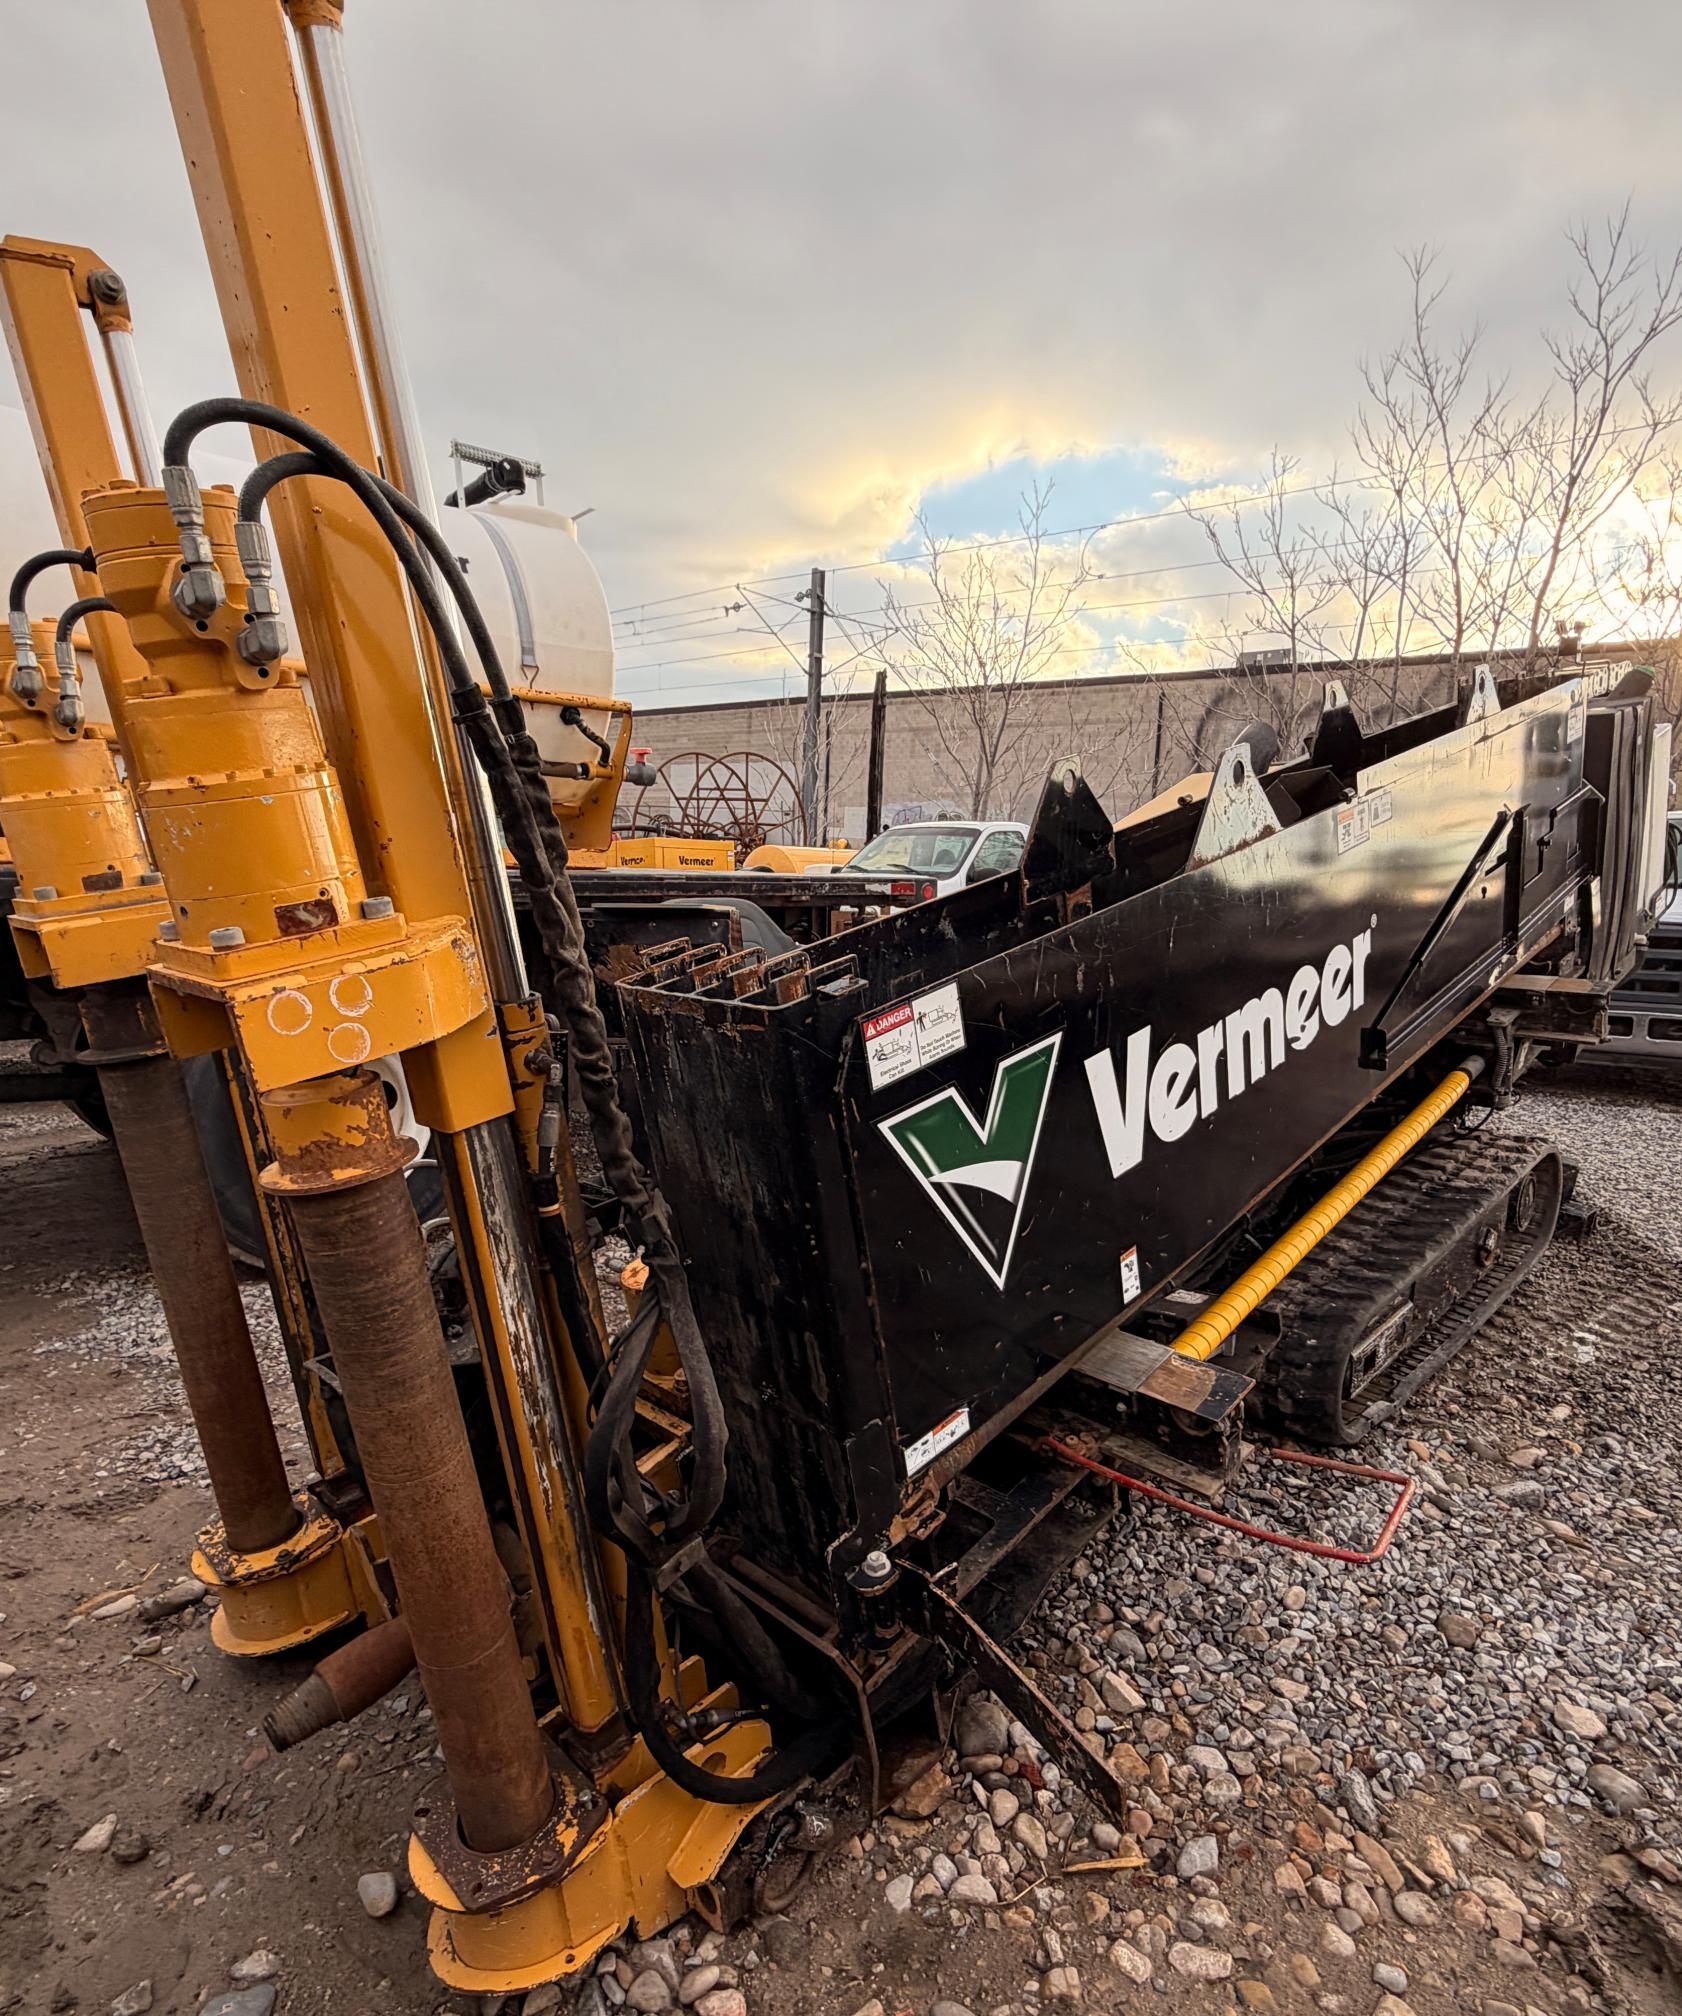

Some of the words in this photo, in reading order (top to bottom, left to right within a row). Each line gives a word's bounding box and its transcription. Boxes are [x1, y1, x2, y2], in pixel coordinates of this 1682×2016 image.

[678, 856, 715, 867] Vermeer
[876, 1007, 912, 1031] DANGER
[1083, 928, 1372, 1179] Vermeer
